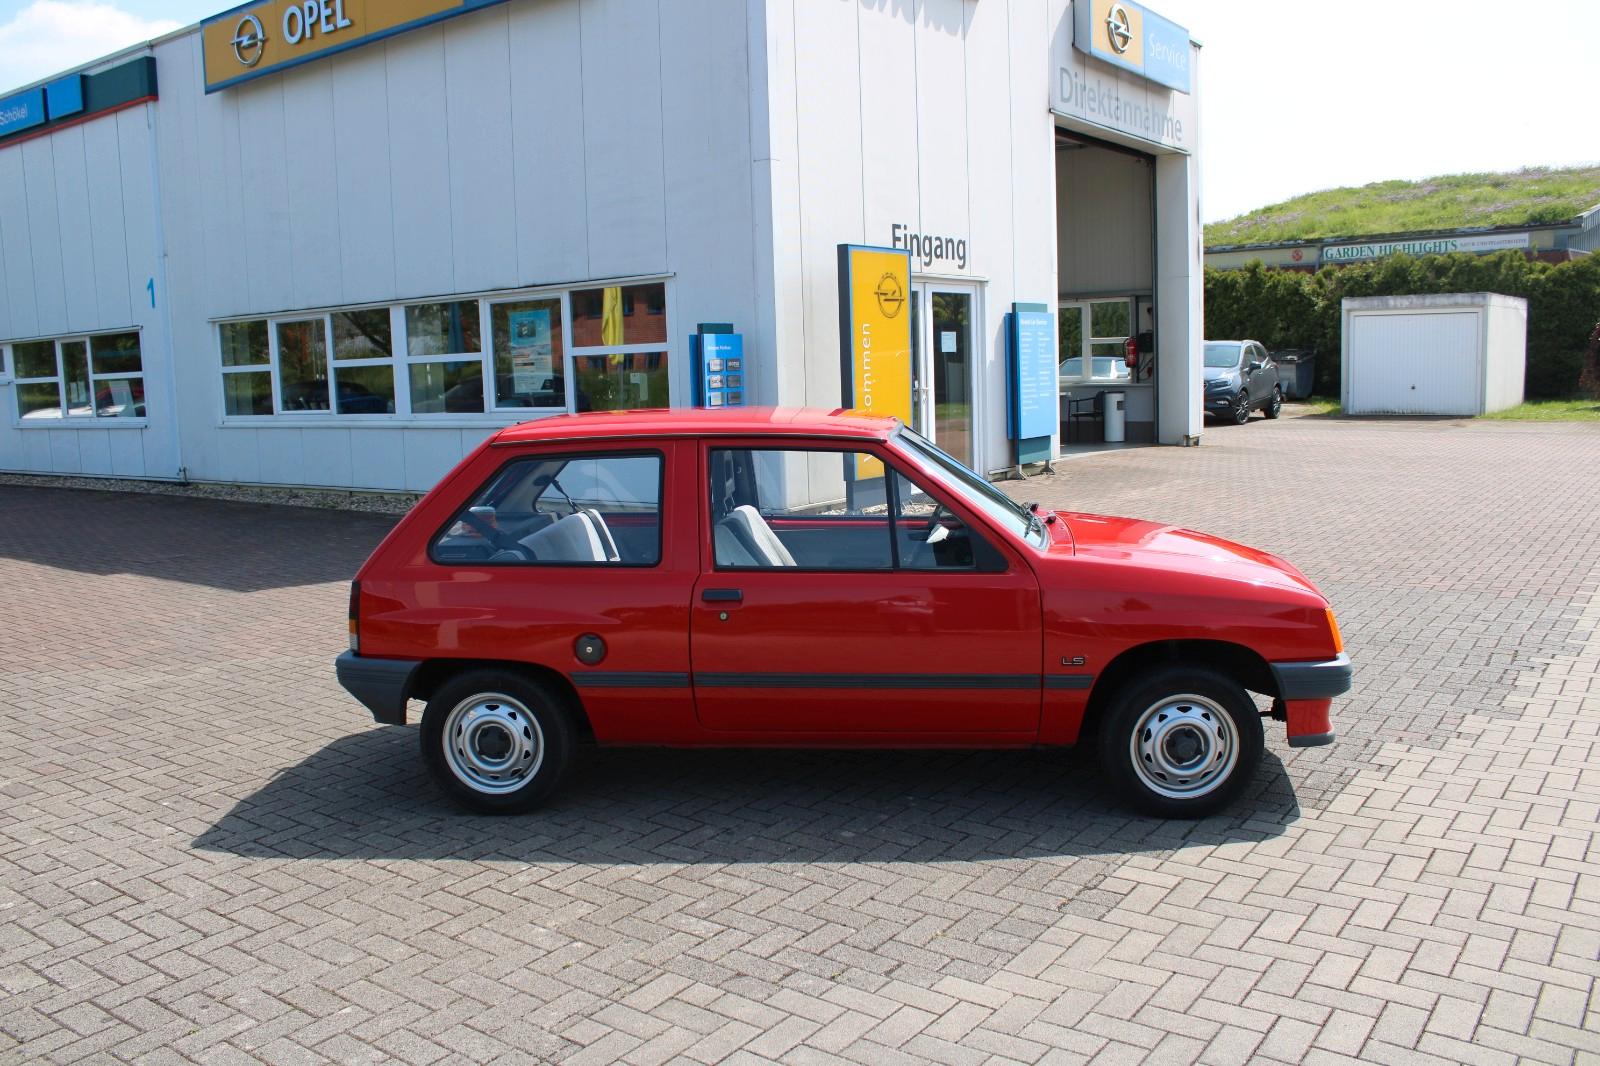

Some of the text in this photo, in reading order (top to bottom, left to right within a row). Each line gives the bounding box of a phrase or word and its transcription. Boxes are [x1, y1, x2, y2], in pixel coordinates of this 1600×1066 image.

[282, 0, 352, 45] OPEL
[1148, 33, 1185, 71] Service
[1059, 66, 1182, 142] Direktannahme
[891, 223, 967, 270] Eingang
[1325, 245, 1376, 260] GARDEN
[146, 277, 156, 309] 1
[862, 323, 872, 412] ommen
[1062, 656, 1084, 665] LS
